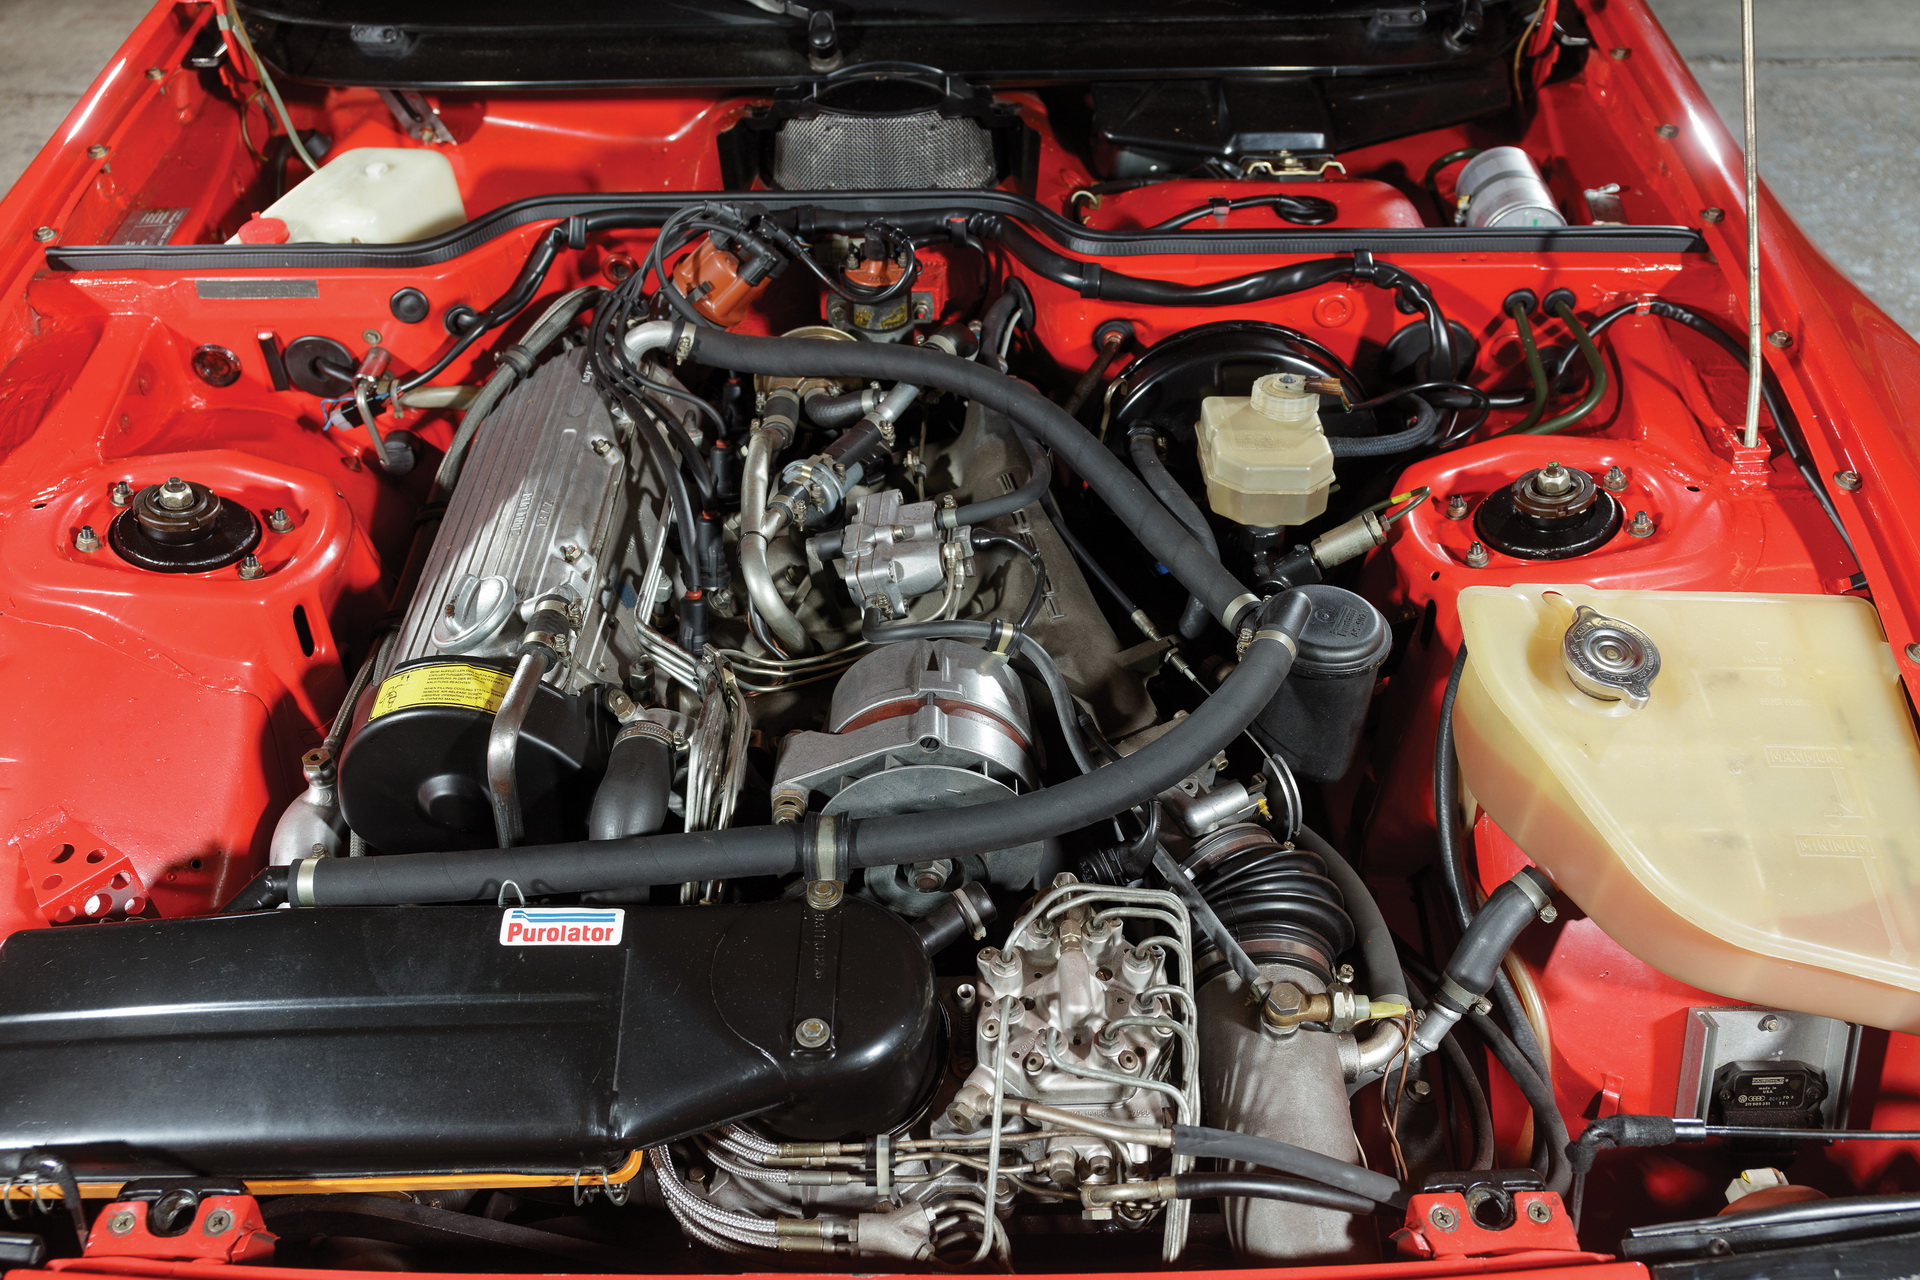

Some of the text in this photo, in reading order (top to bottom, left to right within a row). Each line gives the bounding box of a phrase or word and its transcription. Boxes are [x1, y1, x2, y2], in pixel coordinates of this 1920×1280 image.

[1769, 750, 1839, 764] MAXIMUM
[1798, 838, 1870, 853] MINIMUM
[507, 923, 614, 942] Purolator
